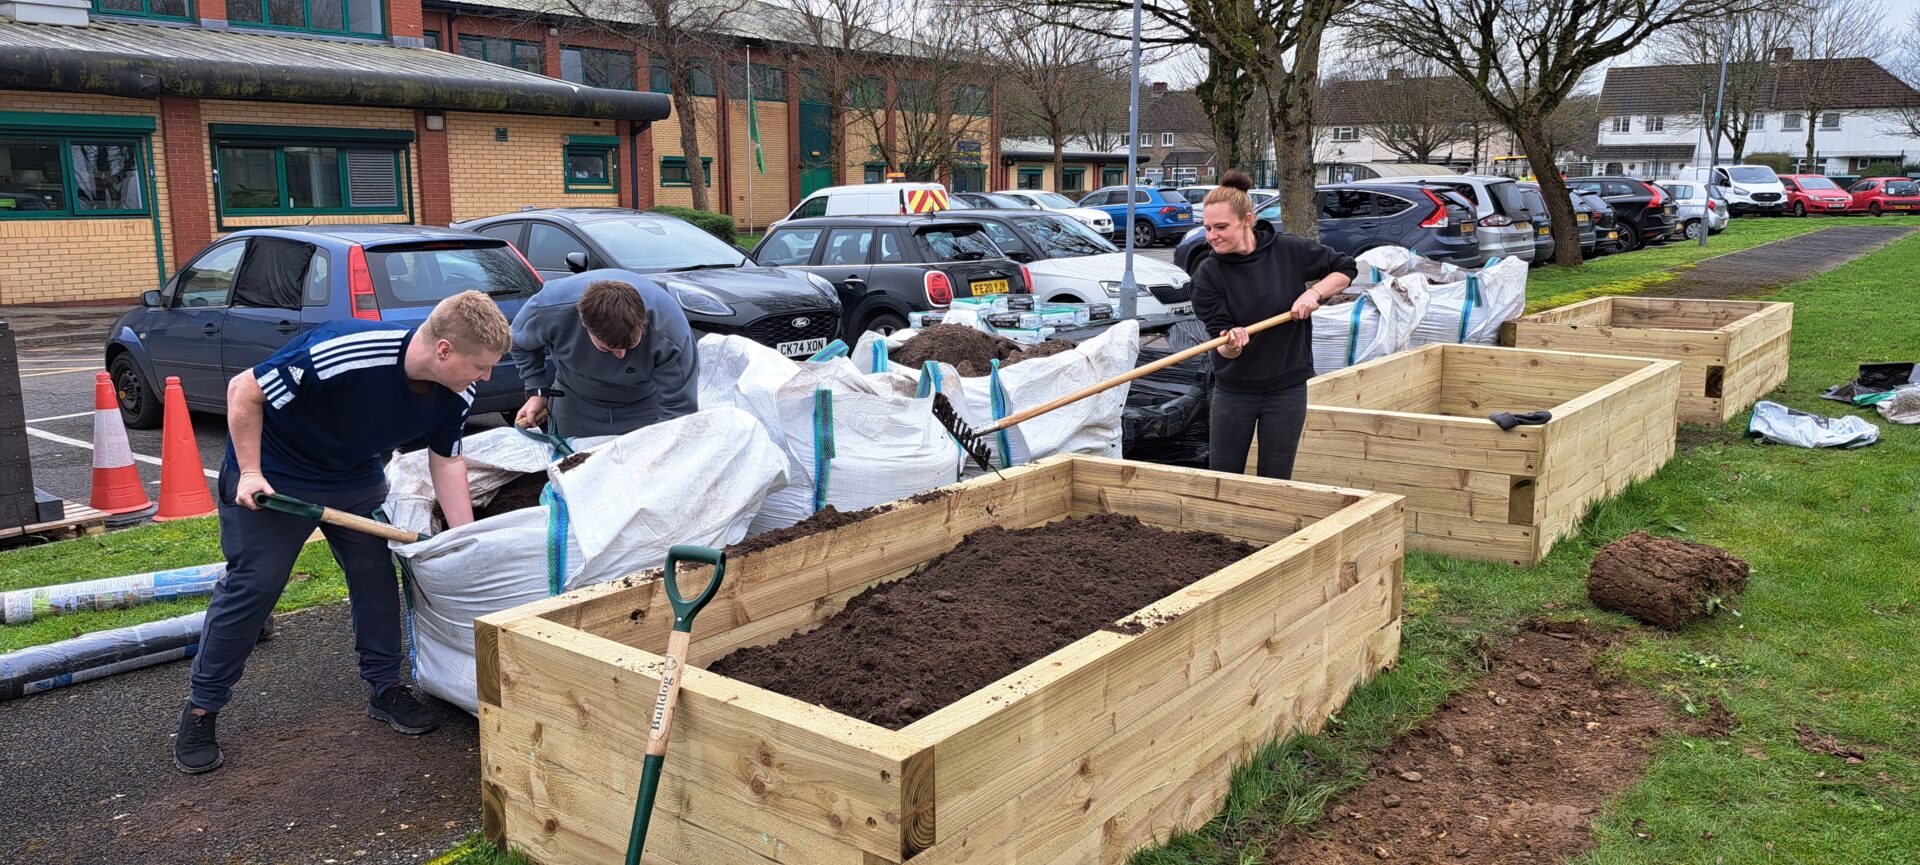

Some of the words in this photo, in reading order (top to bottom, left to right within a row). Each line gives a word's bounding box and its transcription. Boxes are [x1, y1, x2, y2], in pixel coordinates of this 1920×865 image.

[974, 283, 993, 294] FE20
[781, 342, 805, 356] CK74
[806, 339, 824, 352] XON
[651, 676, 675, 731] Bulldog
